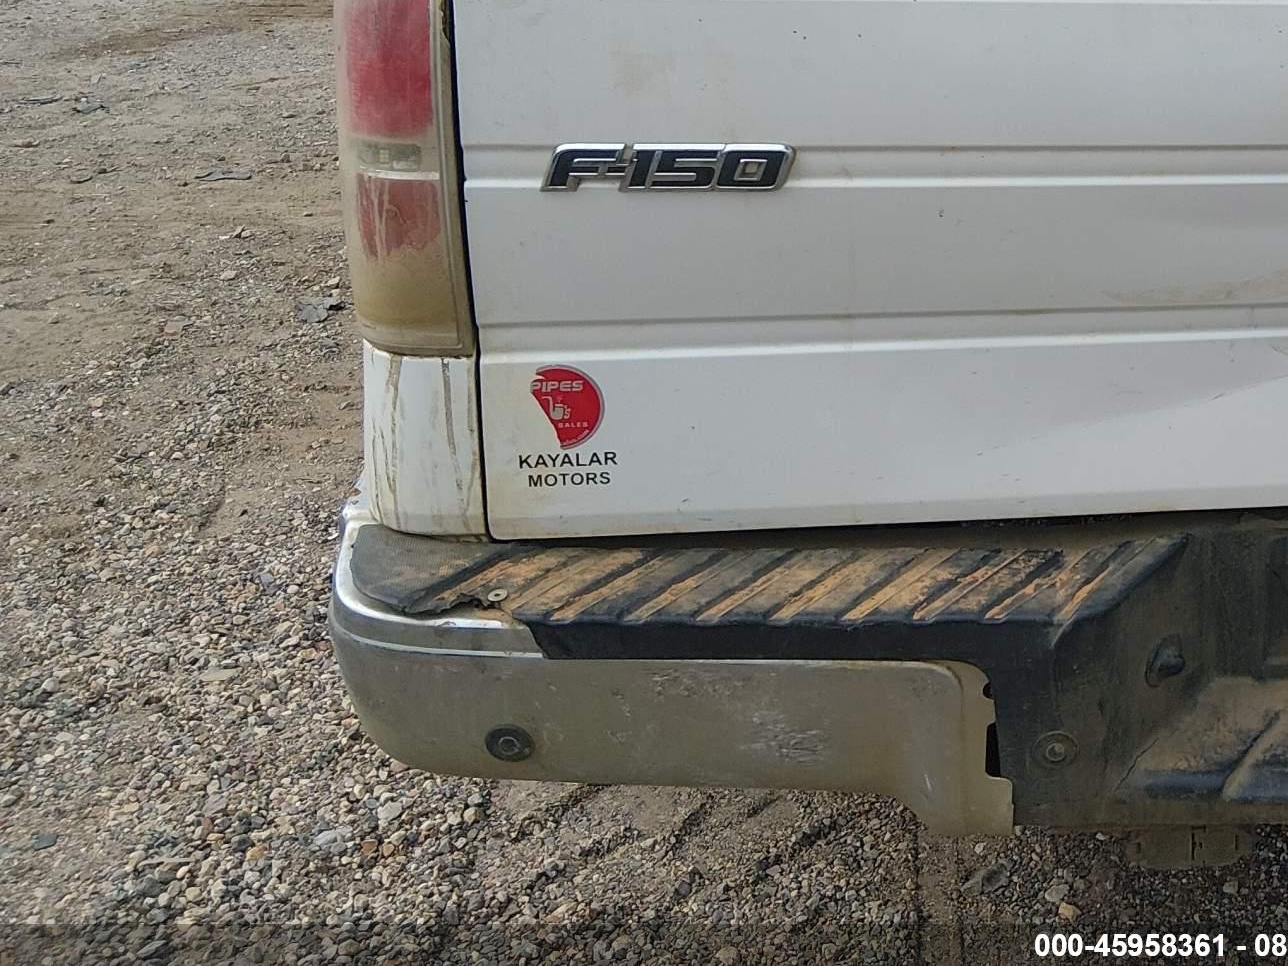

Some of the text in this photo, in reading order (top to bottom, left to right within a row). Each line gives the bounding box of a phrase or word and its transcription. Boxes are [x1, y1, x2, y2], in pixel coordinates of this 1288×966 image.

[539, 142, 797, 191] F-150
[518, 451, 618, 469] KAYALAR
[528, 472, 611, 487] MOTORS
